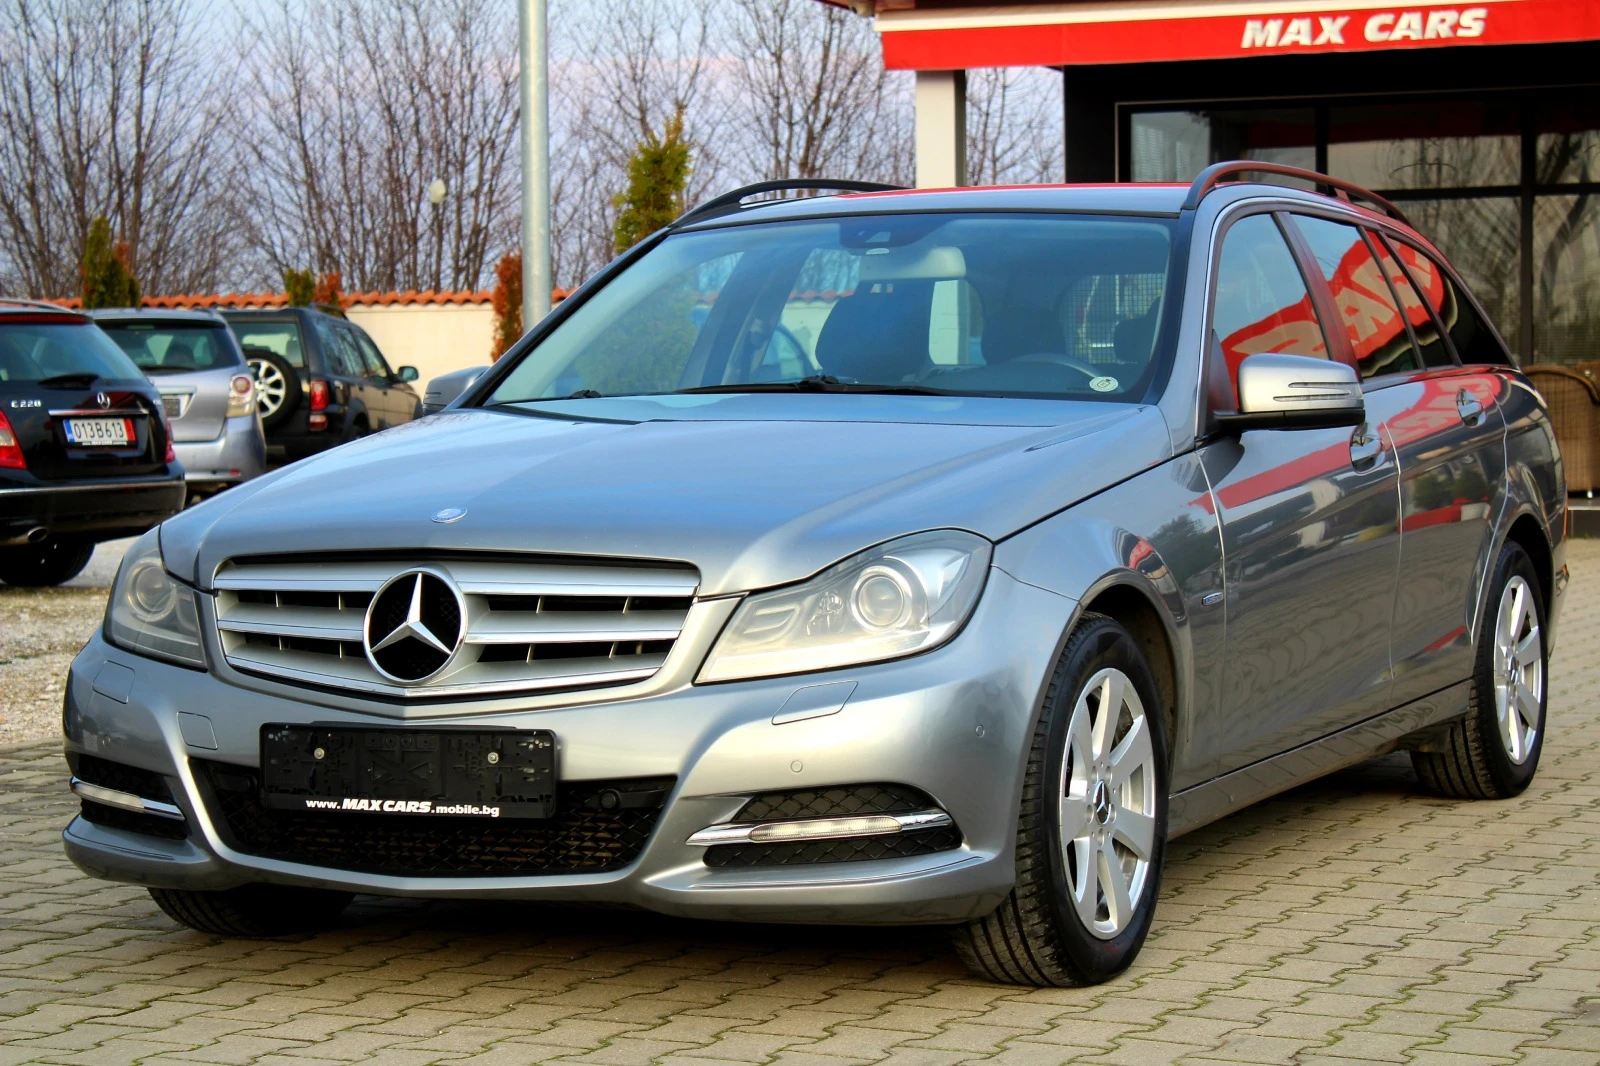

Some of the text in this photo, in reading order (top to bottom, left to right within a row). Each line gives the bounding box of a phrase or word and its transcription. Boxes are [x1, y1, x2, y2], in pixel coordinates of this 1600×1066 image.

[1240, 8, 1488, 48] MAX CARS
[20, 400, 42, 408] 220
[73, 422, 124, 439] 013B613
